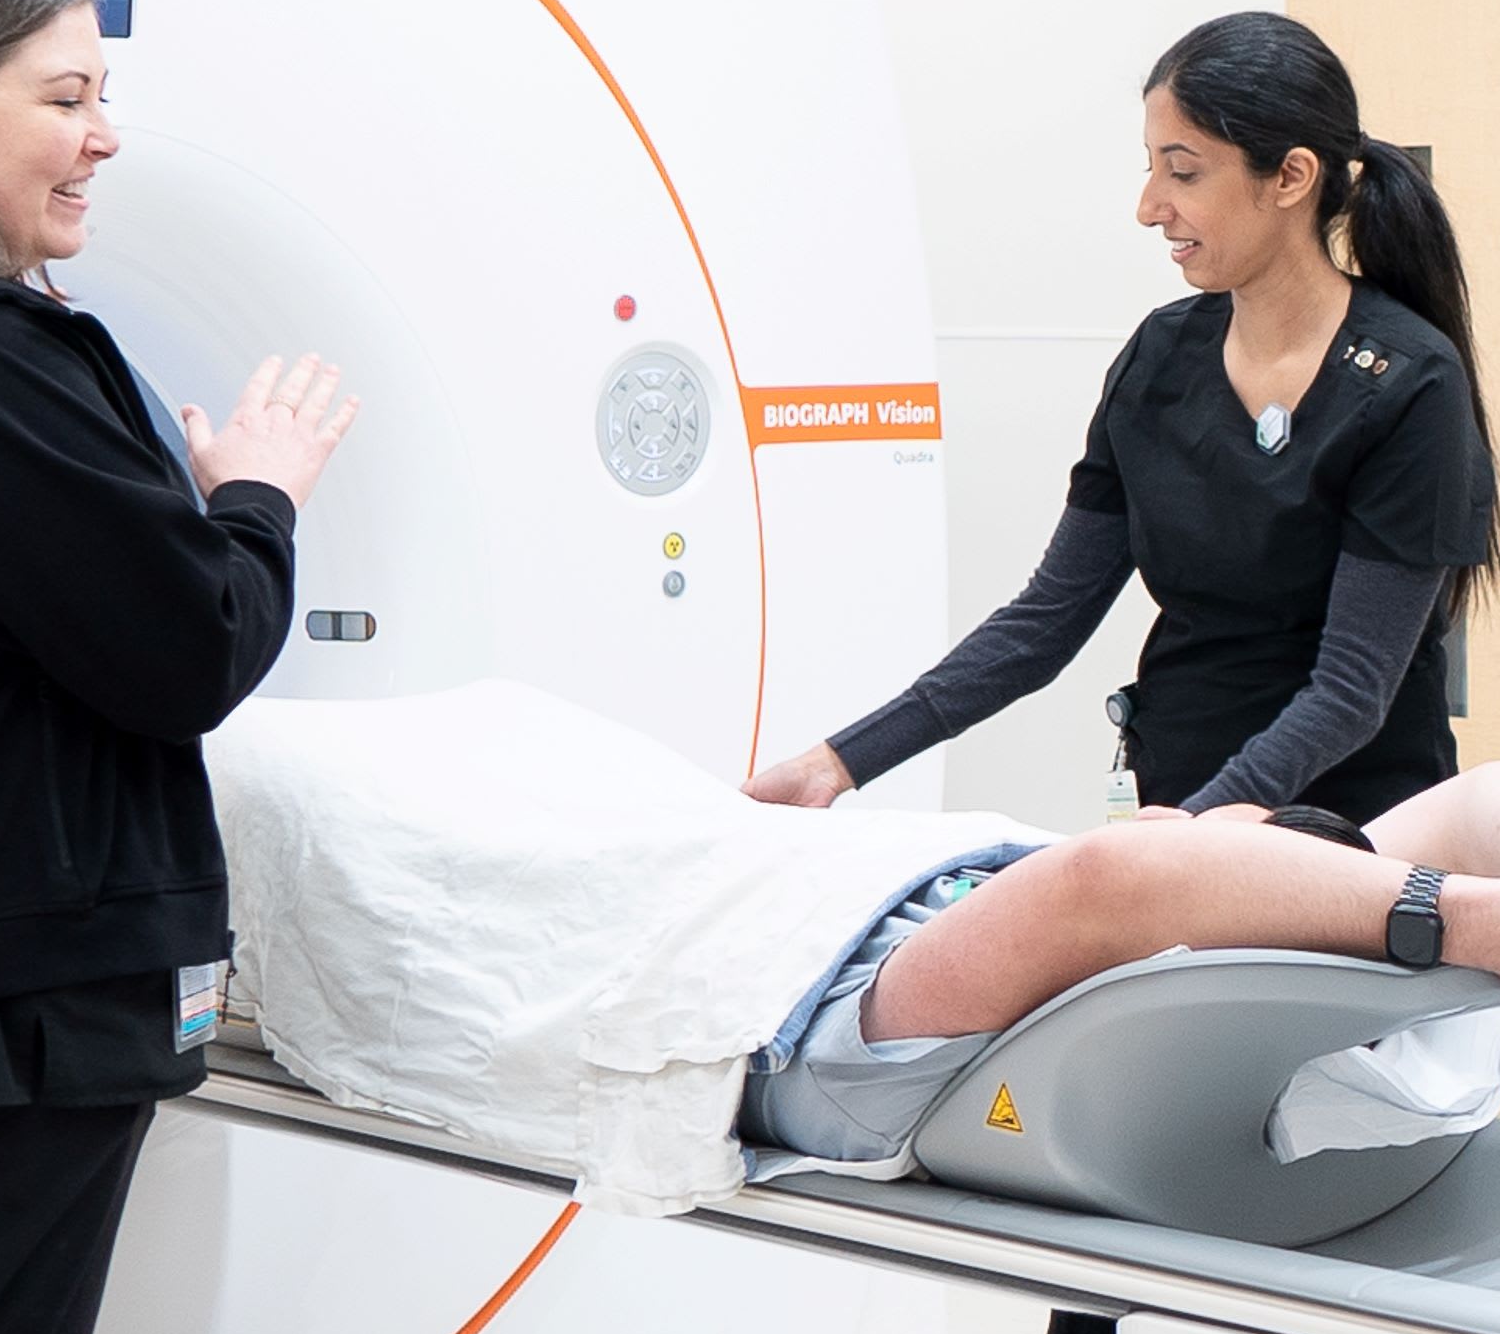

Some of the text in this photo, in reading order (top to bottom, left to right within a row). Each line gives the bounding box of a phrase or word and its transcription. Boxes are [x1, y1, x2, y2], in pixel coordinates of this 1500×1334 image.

[763, 399, 936, 428] BIOGRAPH Vision
[893, 450, 935, 465] Quadra
